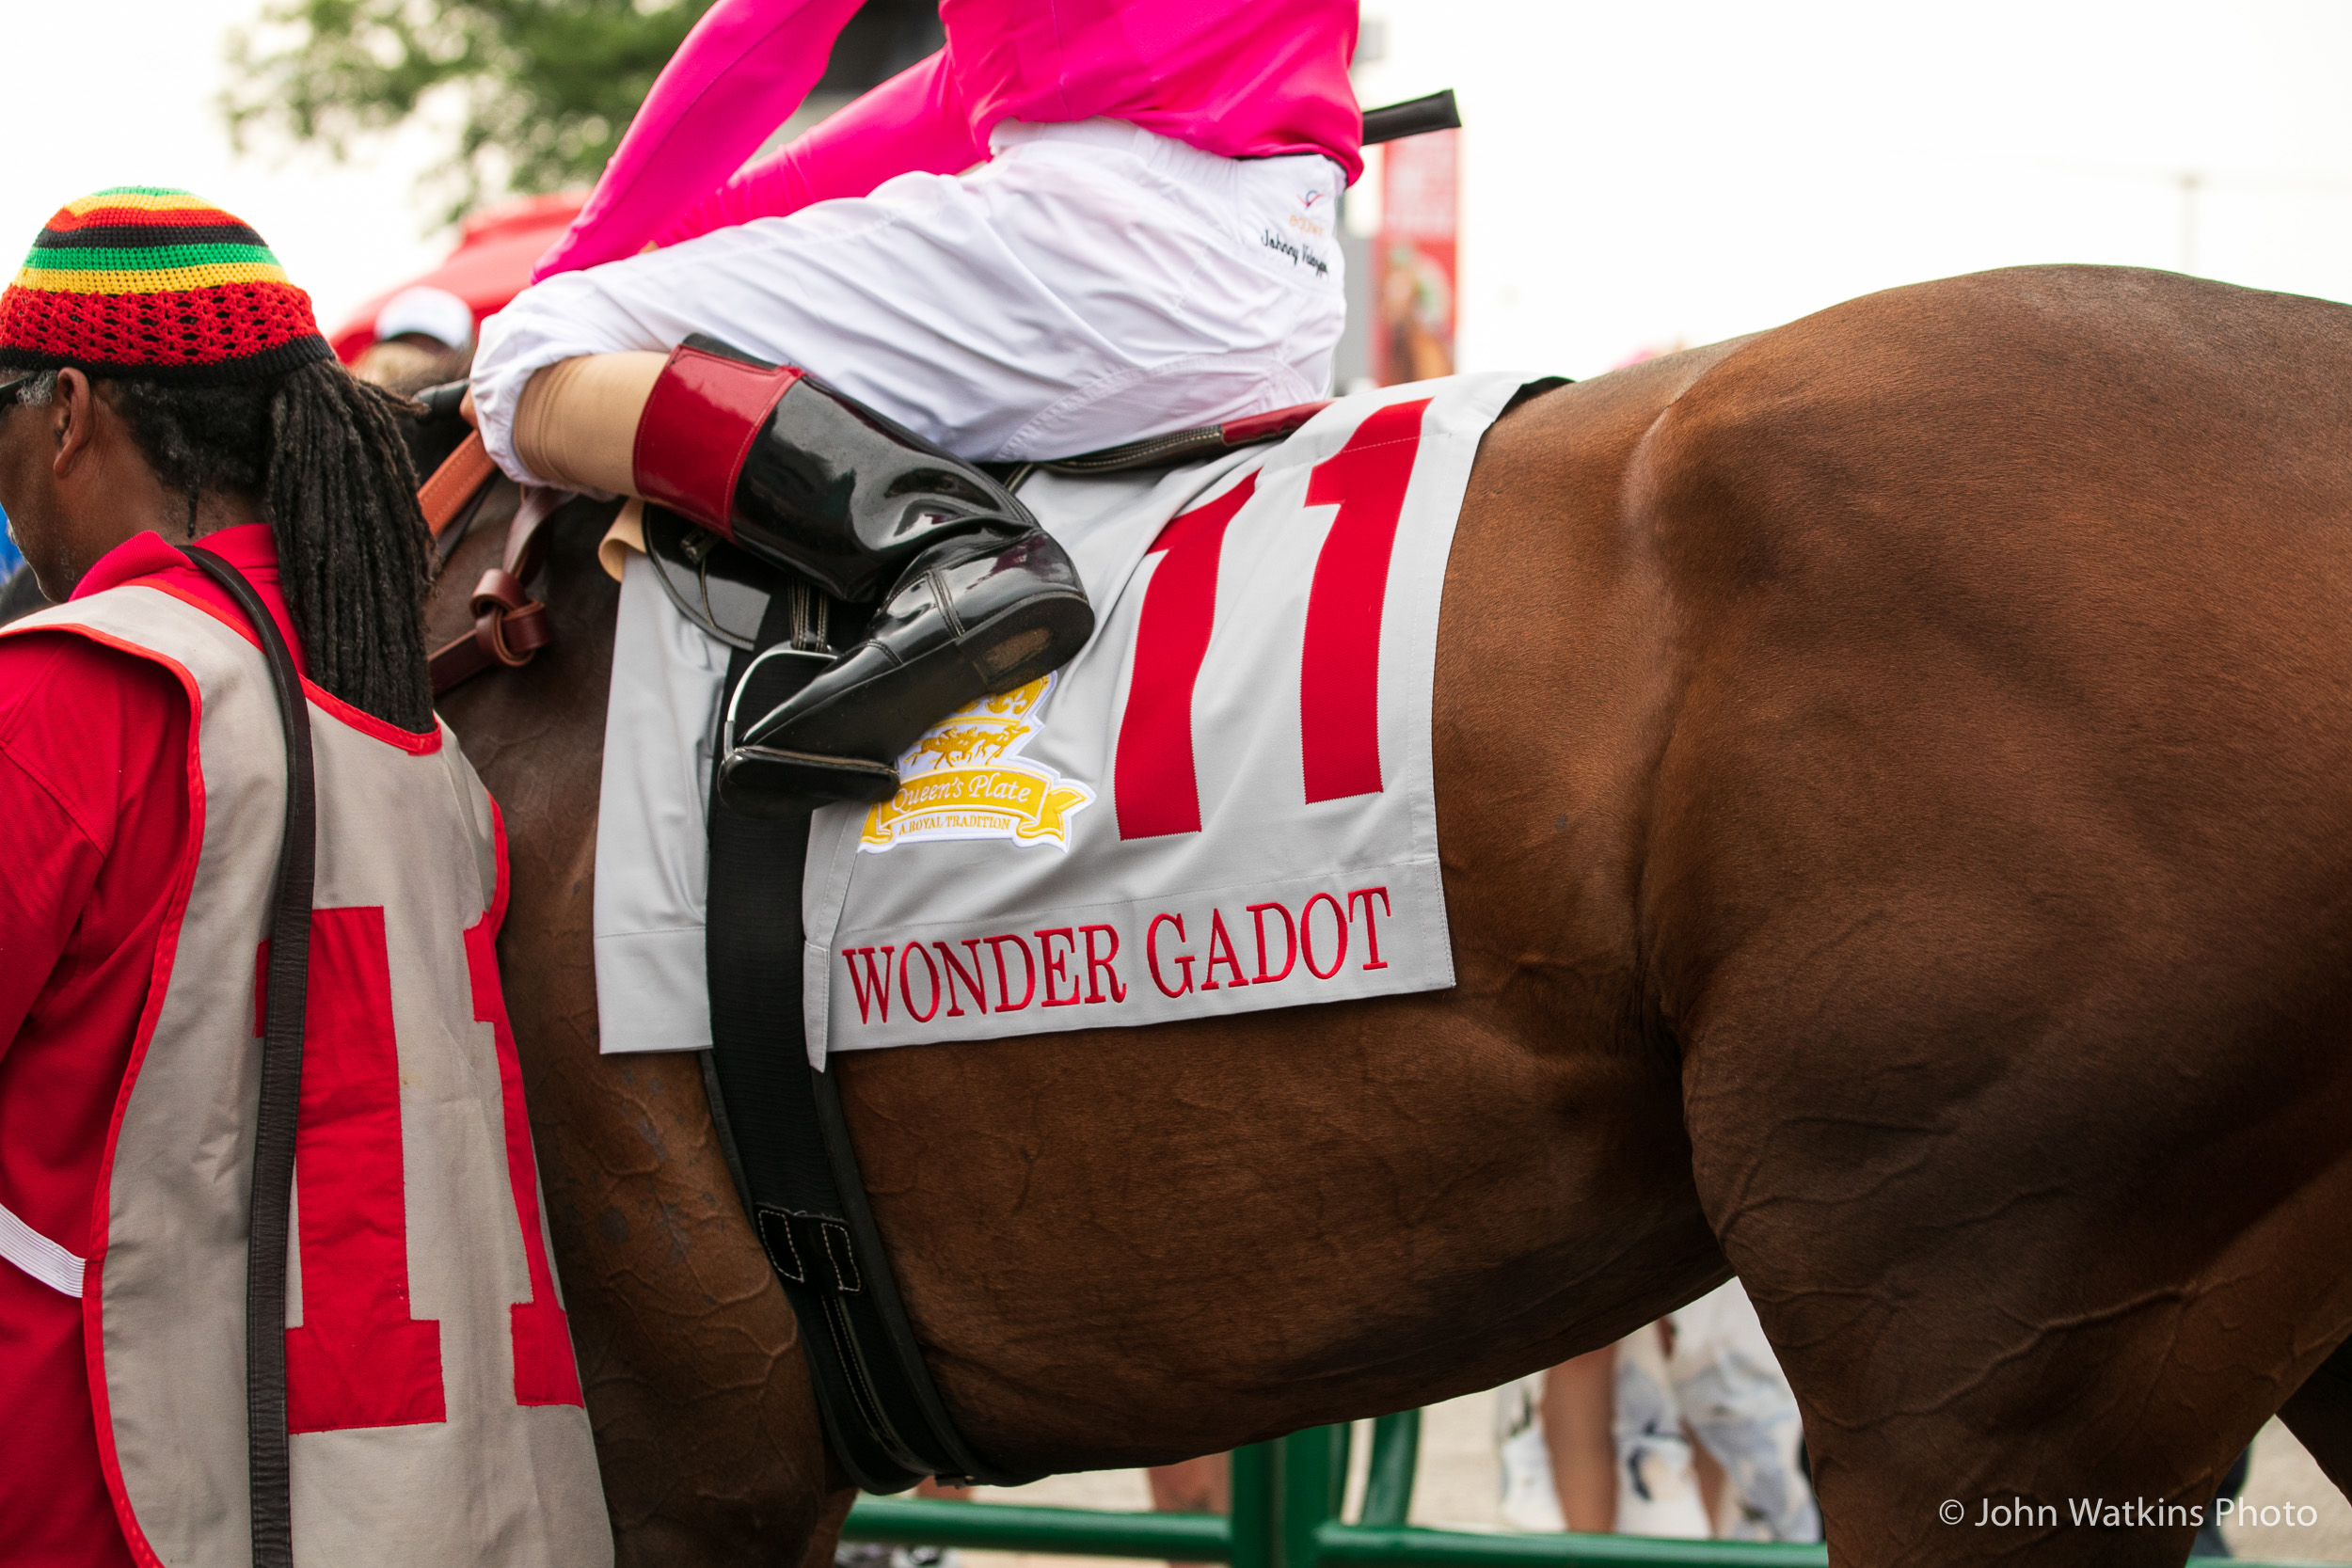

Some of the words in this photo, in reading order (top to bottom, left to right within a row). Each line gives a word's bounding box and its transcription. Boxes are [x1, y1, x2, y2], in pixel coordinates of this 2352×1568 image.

[1114, 396, 1437, 842] 11
[891, 776, 964, 815] Queen's
[968, 772, 1031, 802] Plate
[898, 824, 906, 836] A
[909, 816, 944, 833] ROYAL
[945, 815, 1011, 831] TRADITION
[841, 924, 1127, 1026] WONDER
[1146, 886, 1391, 999] GADOT
